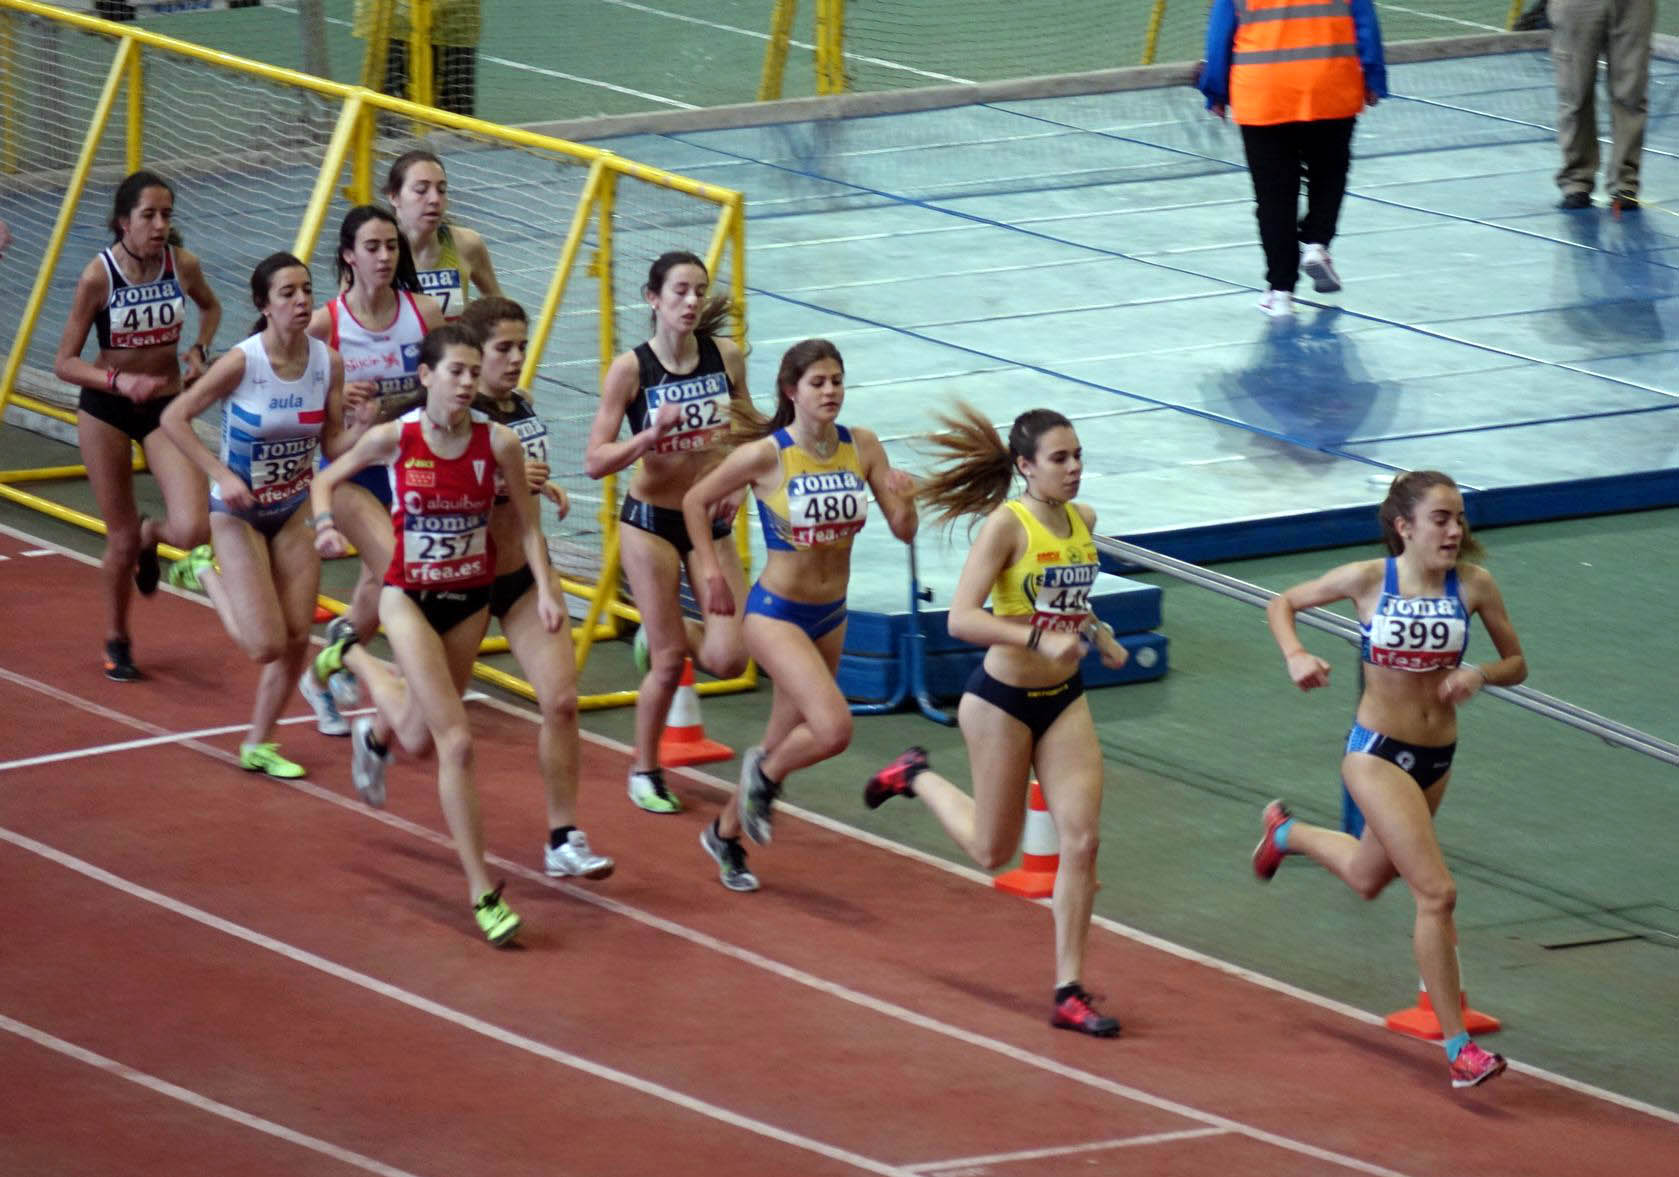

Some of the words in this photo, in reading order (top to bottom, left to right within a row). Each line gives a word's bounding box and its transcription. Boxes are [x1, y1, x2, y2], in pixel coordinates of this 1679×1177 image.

[116, 283, 176, 307] Joma
[124, 303, 174, 330] 410
[269, 394, 303, 410] aula
[654, 377, 720, 407] Joma
[258, 437, 318, 460] Joma
[793, 472, 857, 495] Joma
[804, 494, 857, 522] 480
[412, 514, 481, 531] Joma
[419, 533, 474, 560] 257
[411, 560, 481, 582] rfea.es
[1382, 598, 1456, 616] Joma
[1386, 620, 1450, 650] 399
